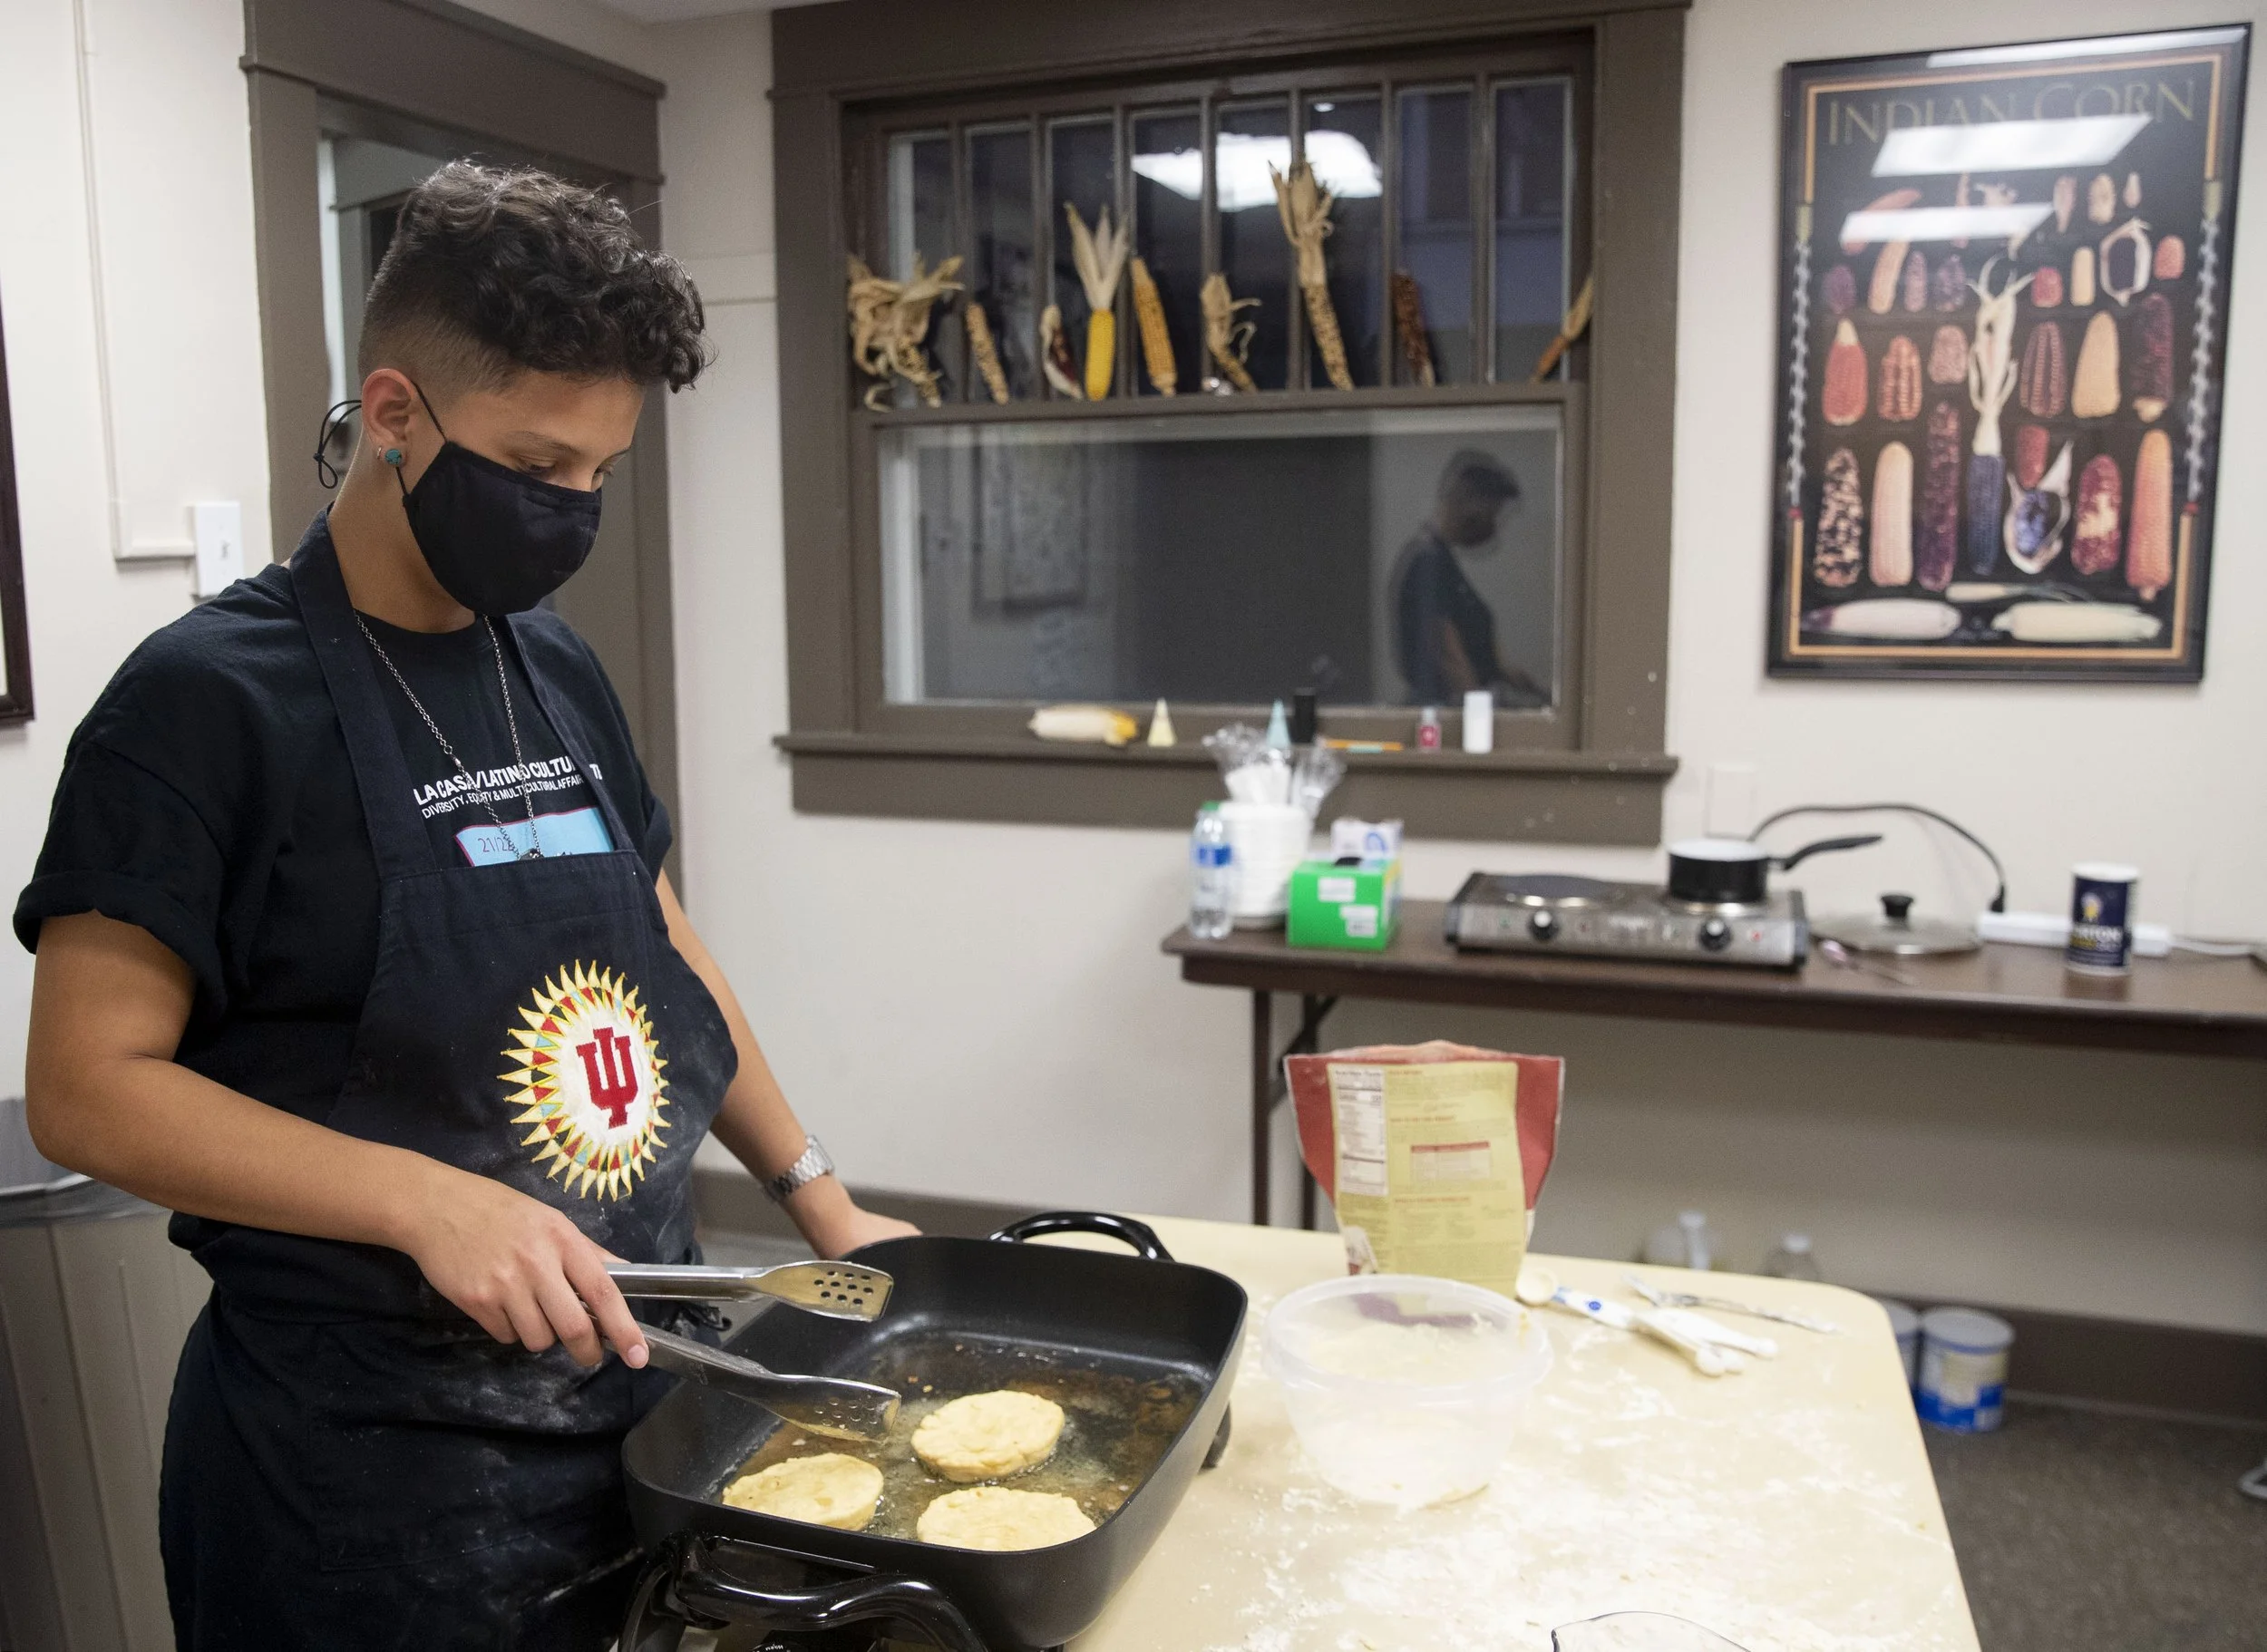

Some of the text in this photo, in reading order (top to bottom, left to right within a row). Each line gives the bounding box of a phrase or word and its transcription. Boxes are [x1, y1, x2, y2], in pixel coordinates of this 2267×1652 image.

[1828, 81, 2194, 145] INDIAN CORN
[414, 783, 439, 805] LA
[493, 790, 501, 802] &
